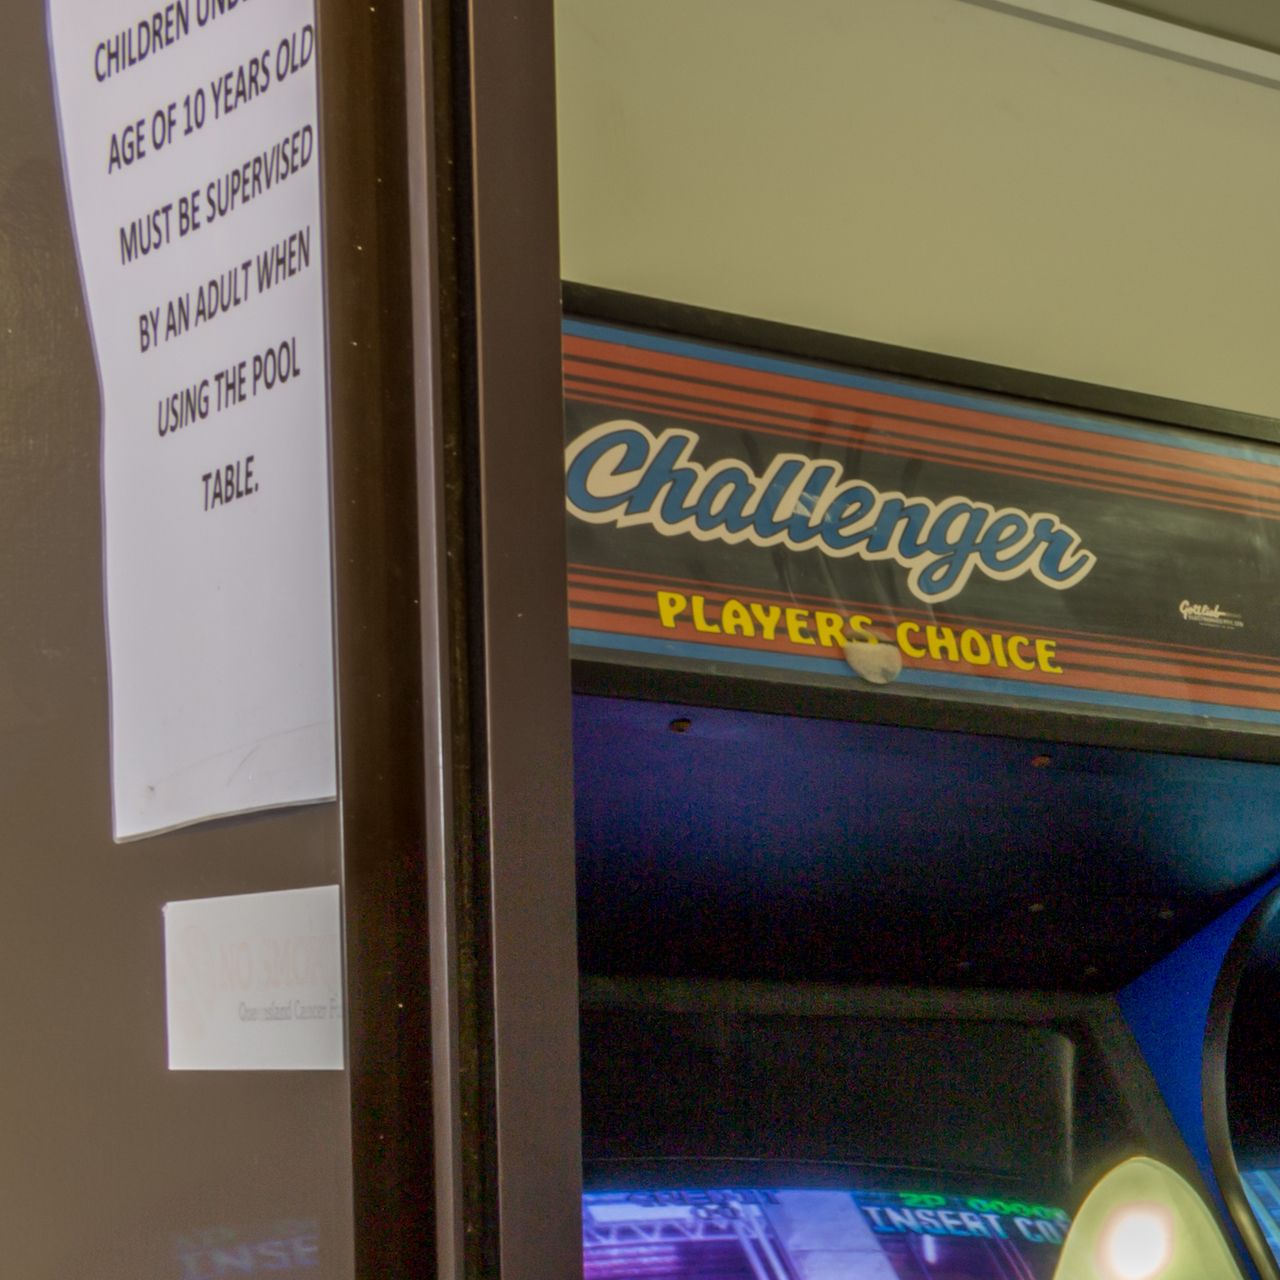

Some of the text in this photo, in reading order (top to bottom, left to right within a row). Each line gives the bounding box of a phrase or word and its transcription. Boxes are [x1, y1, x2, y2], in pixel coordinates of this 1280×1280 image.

[94, 0, 189, 82] CHILDREN
[108, 24, 314, 174] AGE OF 10 YEARS OLD
[119, 124, 314, 265] MUST BE SUPERVISED
[138, 225, 311, 353] BY AN ADULT WHEN
[157, 336, 301, 437] USING THE POOL
[202, 455, 260, 512] TABLE.
[563, 419, 1098, 604] Challenger
[655, 590, 1064, 675] PLAYERS CHOICE
[861, 1205, 1010, 1239] INSERT
